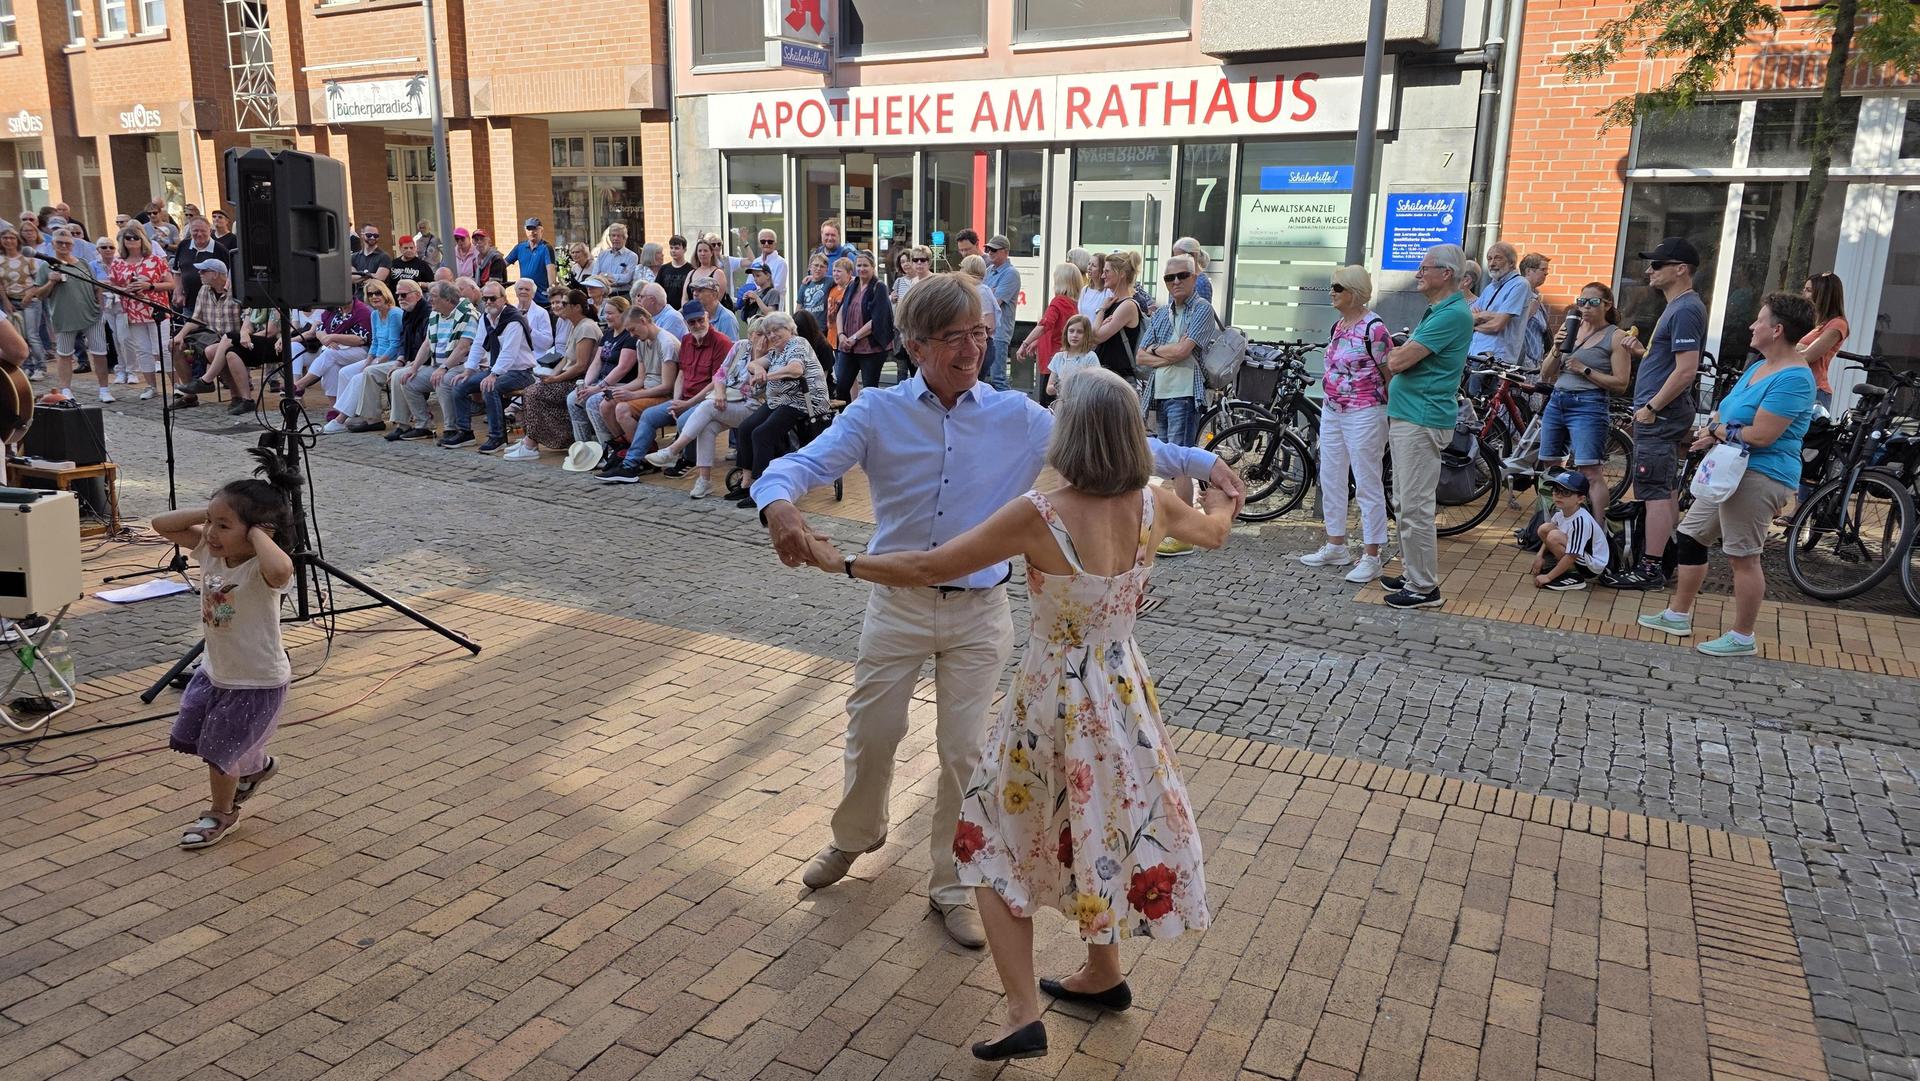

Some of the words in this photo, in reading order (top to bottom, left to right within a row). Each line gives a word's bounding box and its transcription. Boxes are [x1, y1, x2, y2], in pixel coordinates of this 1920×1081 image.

[336, 100, 413, 118] Bücherparadies
[748, 93, 954, 140] APOTHEKE
[970, 88, 1045, 133] AM
[1066, 72, 1320, 130] RATHAUS
[8, 110, 43, 133] SHOES
[119, 103, 161, 129] SHOES
[1442, 151, 1454, 168] 7
[1288, 170, 1339, 185] Schülerhilfe!
[1196, 177, 1217, 212] 7
[731, 199, 758, 209] apogen
[1250, 197, 1336, 213] ANWALTSKANZLEI
[1396, 198, 1456, 213] Schülerhilfe!
[1288, 216, 1322, 224] ANDREA
